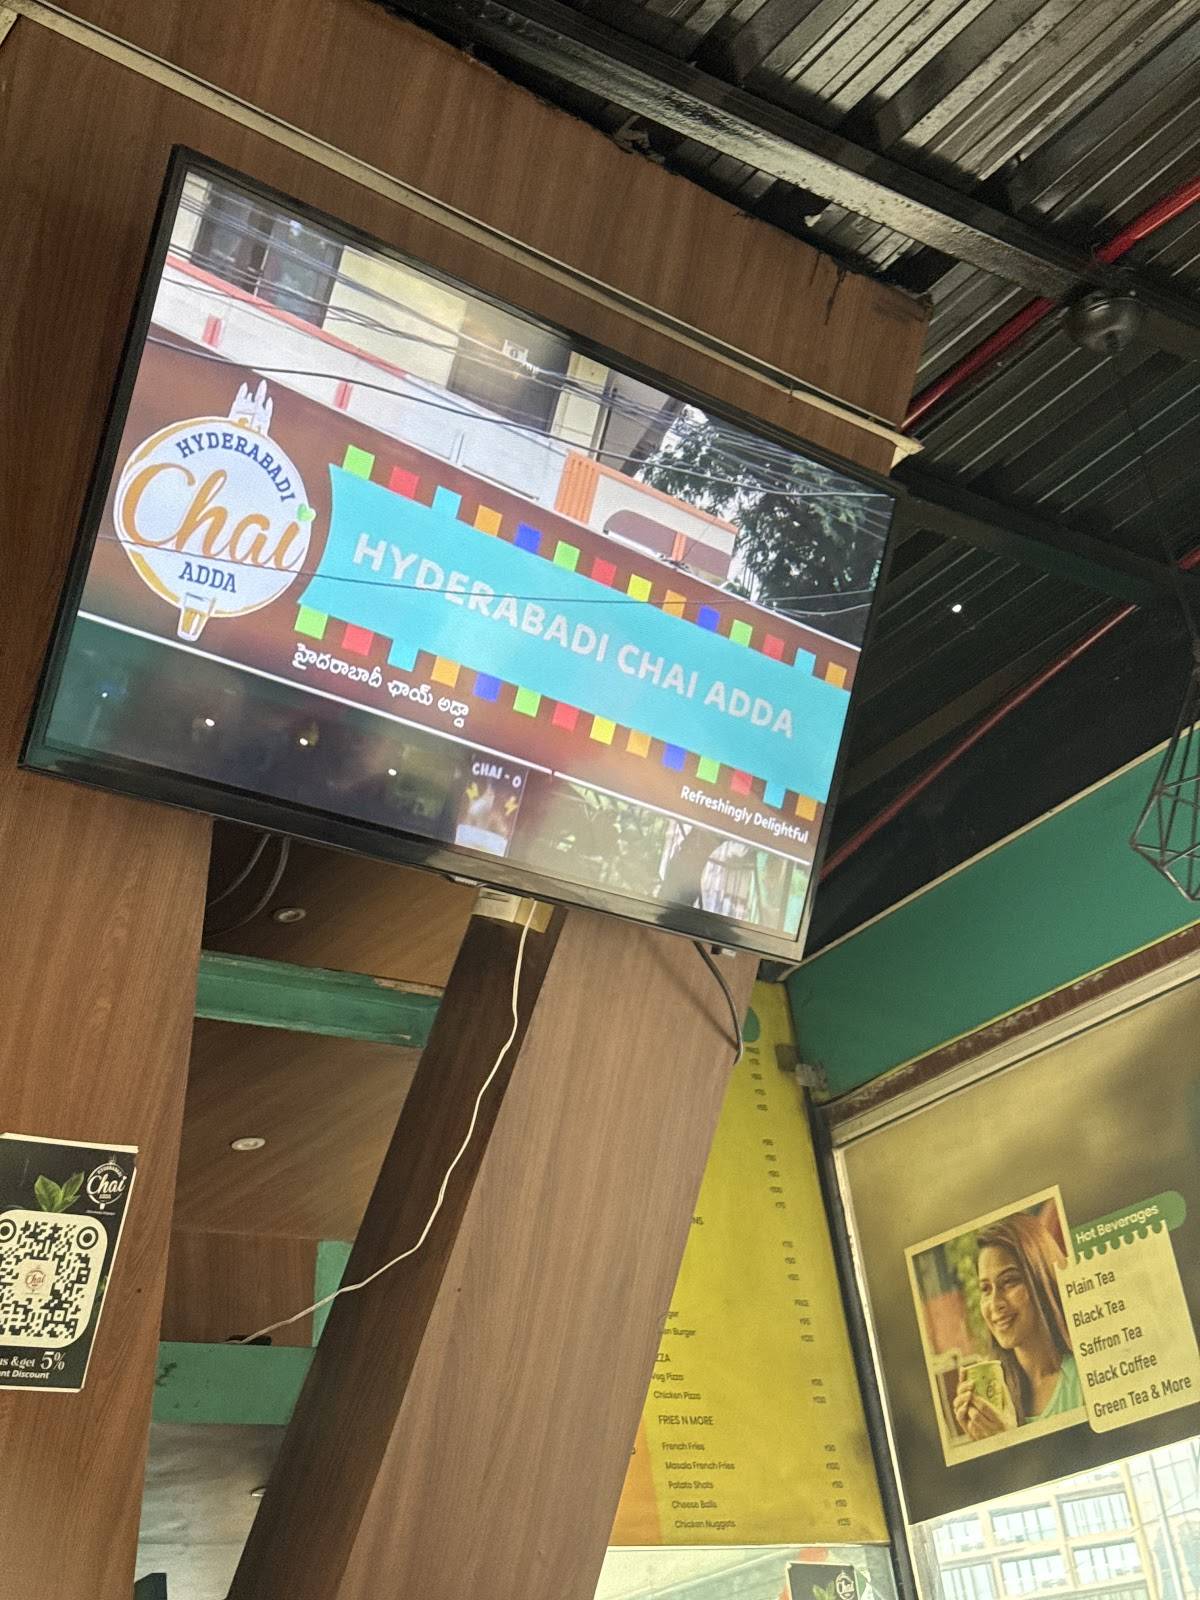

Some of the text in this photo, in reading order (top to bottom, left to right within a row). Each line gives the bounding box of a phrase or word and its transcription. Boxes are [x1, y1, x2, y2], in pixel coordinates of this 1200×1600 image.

[176, 431, 296, 503] HYDERABADI
[122, 462, 305, 571] Chai
[179, 561, 237, 593] ADDA
[351, 532, 795, 739] HYDERABADI CHAI ADDA
[472, 762, 503, 780] CHAI
[680, 785, 811, 846] Refreshingly Delightful
[87, 1173, 127, 1194] Chai
[1076, 1204, 1160, 1244] Hot Beverages
[1066, 1269, 1116, 1298] Plain Tea
[1072, 1298, 1126, 1328] Black Tea
[673, 1327, 696, 1338] Burger
[1079, 1325, 1143, 1357] Saffron Tea
[40, 1351, 66, 1371] 5%
[1086, 1352, 1158, 1387] Black Coffee
[12, 1369, 50, 1380] Discount
[653, 1390, 682, 1400] Chicken
[1094, 1375, 1192, 1418] Green Tea & More
[658, 1415, 714, 1426] FRIES N MORE
[662, 1441, 705, 1451] French Fries
[665, 1462, 735, 1471] Masala French Fries
[668, 1480, 692, 1489] Potato
[674, 1519, 704, 1529] Chicken
